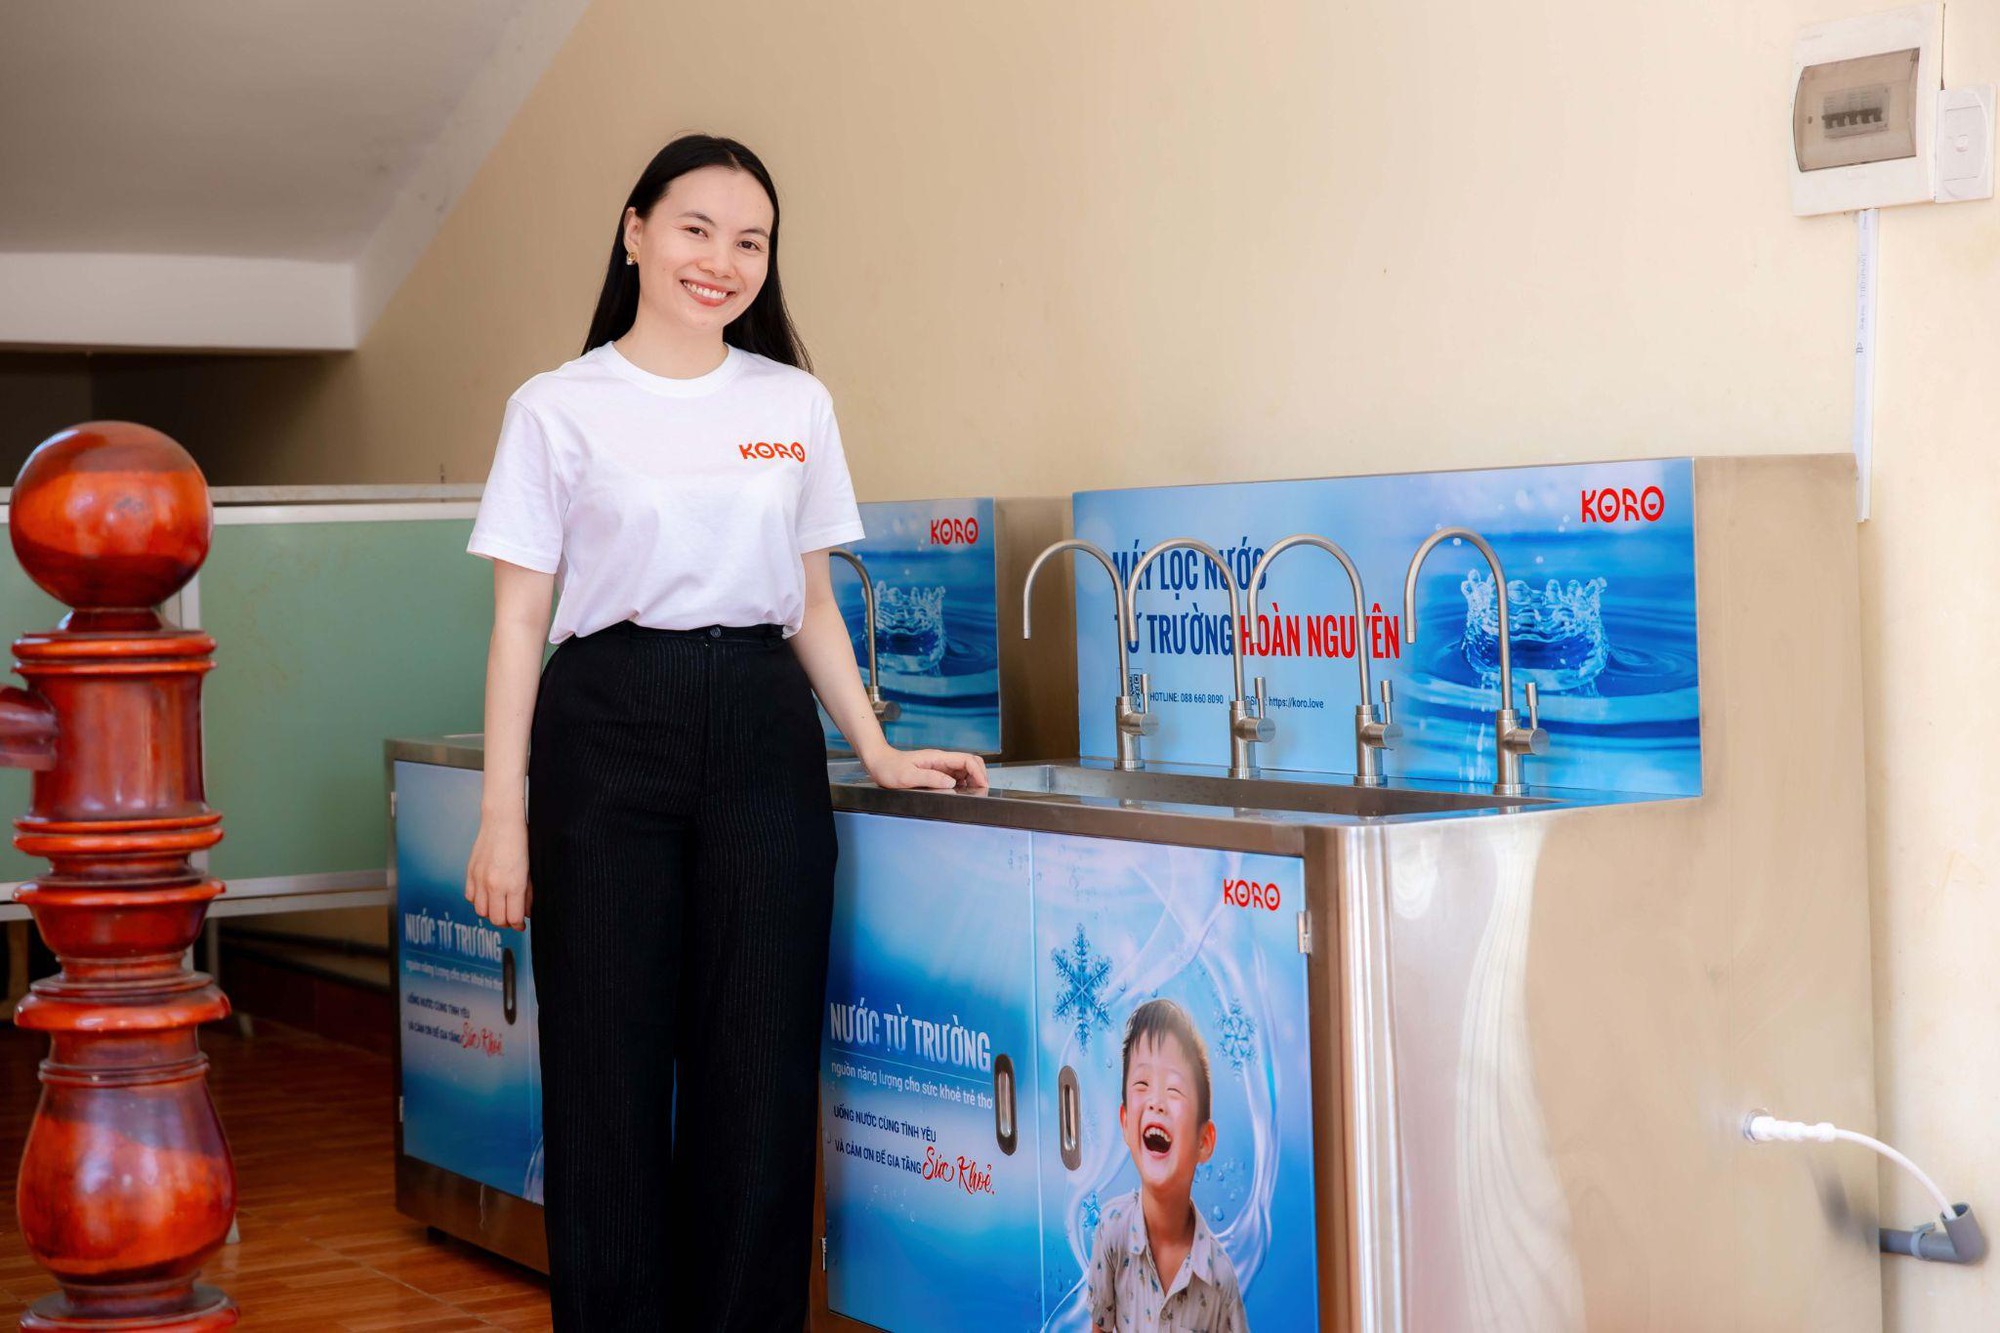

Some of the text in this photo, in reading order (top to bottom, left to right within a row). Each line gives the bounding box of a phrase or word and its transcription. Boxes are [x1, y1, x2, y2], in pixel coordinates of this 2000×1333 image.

[739, 442, 805, 462] KORO
[1582, 486, 1664, 523] KORO
[931, 517, 979, 545] KORO
[1160, 549, 1198, 600] LỌC
[1205, 536, 1267, 590] NƯỚC
[1147, 603, 1234, 655] TRƯỜNG
[1240, 602, 1300, 657] HOÀN
[1307, 603, 1400, 659] NGUÊN
[1150, 692, 1224, 705] HOTLINE: 088 660 8090
[1269, 696, 1324, 709] https://koro.love
[1224, 879, 1280, 911] KORO
[830, 997, 880, 1047] NƯỚC
[912, 1014, 992, 1074] TRƯỜNG
[904, 1076, 920, 1092] cho
[922, 1081, 938, 1096] sức
[977, 1092, 993, 1110] thơ
[855, 1111, 877, 1128] NƯỚC
[901, 1121, 919, 1138] TÌNH
[921, 1126, 937, 1143] YÊU
[887, 1154, 900, 1169] GIA
[922, 1146, 954, 1182] Sức
